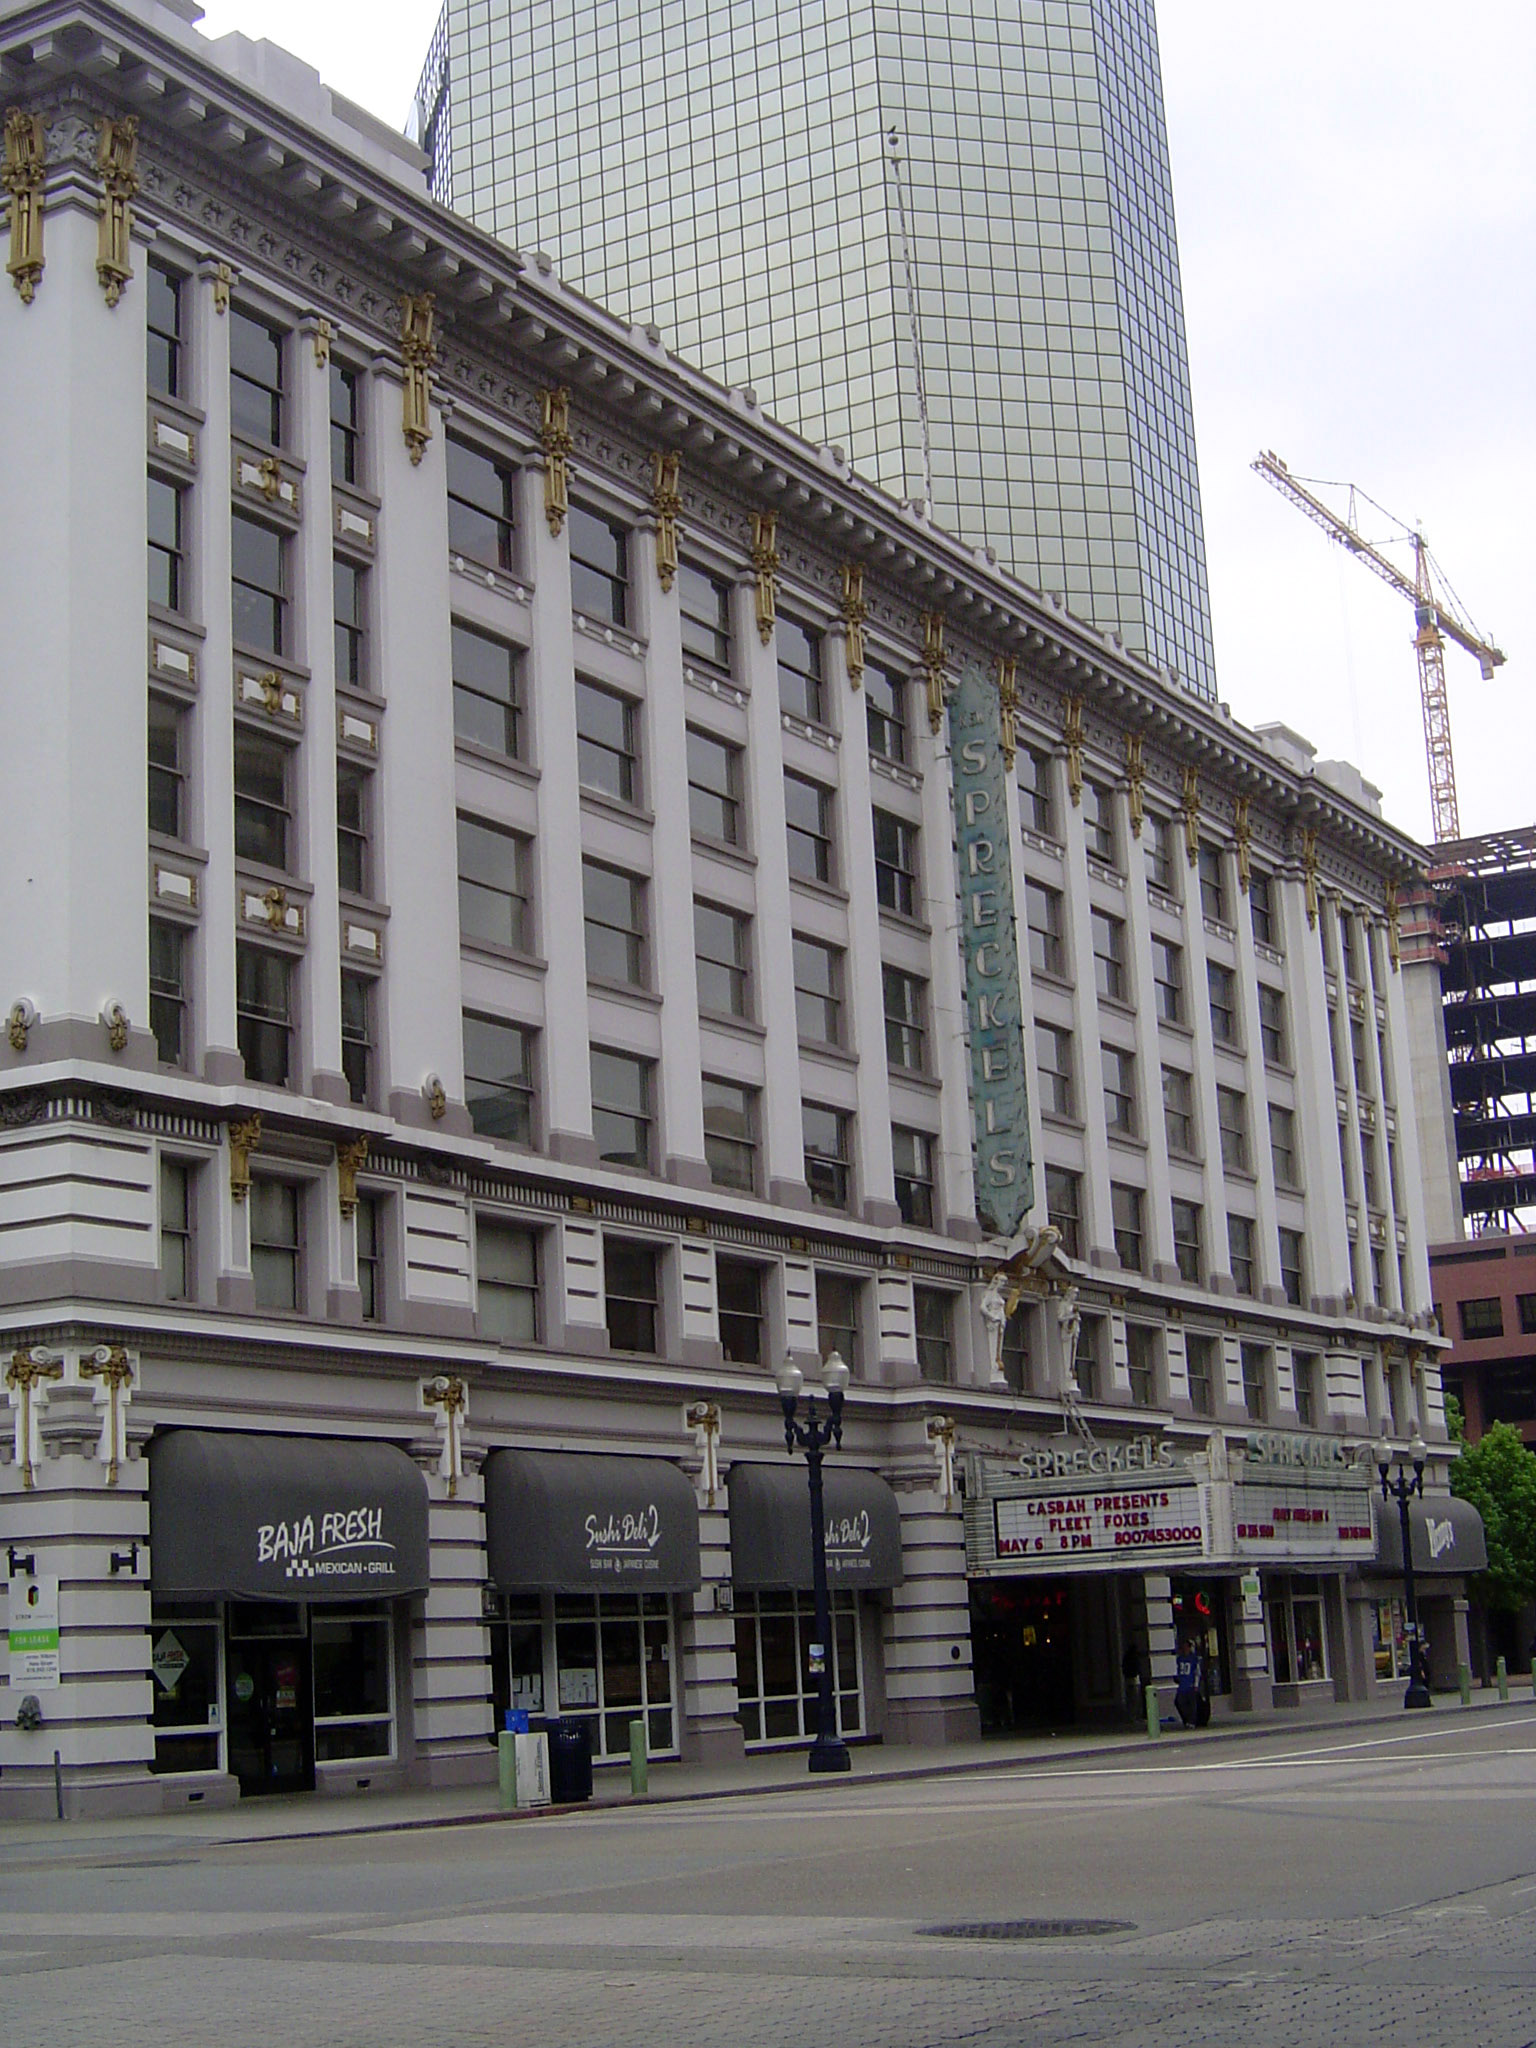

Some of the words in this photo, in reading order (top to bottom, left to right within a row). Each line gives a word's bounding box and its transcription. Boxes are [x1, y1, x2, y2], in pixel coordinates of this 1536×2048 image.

[961, 738, 1016, 1188] SPRECKELS
[1018, 1440, 1176, 1479] SPRECKELS
[1256, 1433, 1349, 1467] SPRECKELS
[1027, 1498, 1086, 1516] CASBAH
[1094, 1492, 1169, 1512] PRESENTS
[257, 1514, 314, 1562] BAJA
[321, 1507, 382, 1545] FRESH
[585, 1514, 621, 1549] Sushi
[622, 1511, 648, 1541] Deli
[840, 1518, 861, 1543] Deli
[1049, 1516, 1093, 1533] FLEET
[1104, 1512, 1150, 1529] FOXES
[999, 1538, 1029, 1553] MAY
[1034, 1537, 1044, 1550] 6
[1060, 1535, 1068, 1549] 8
[1071, 1534, 1092, 1549] PM
[1114, 1526, 1202, 1546] 8007453000
[315, 1562, 362, 1575] MEXICAN
[367, 1562, 396, 1574] GRILL
